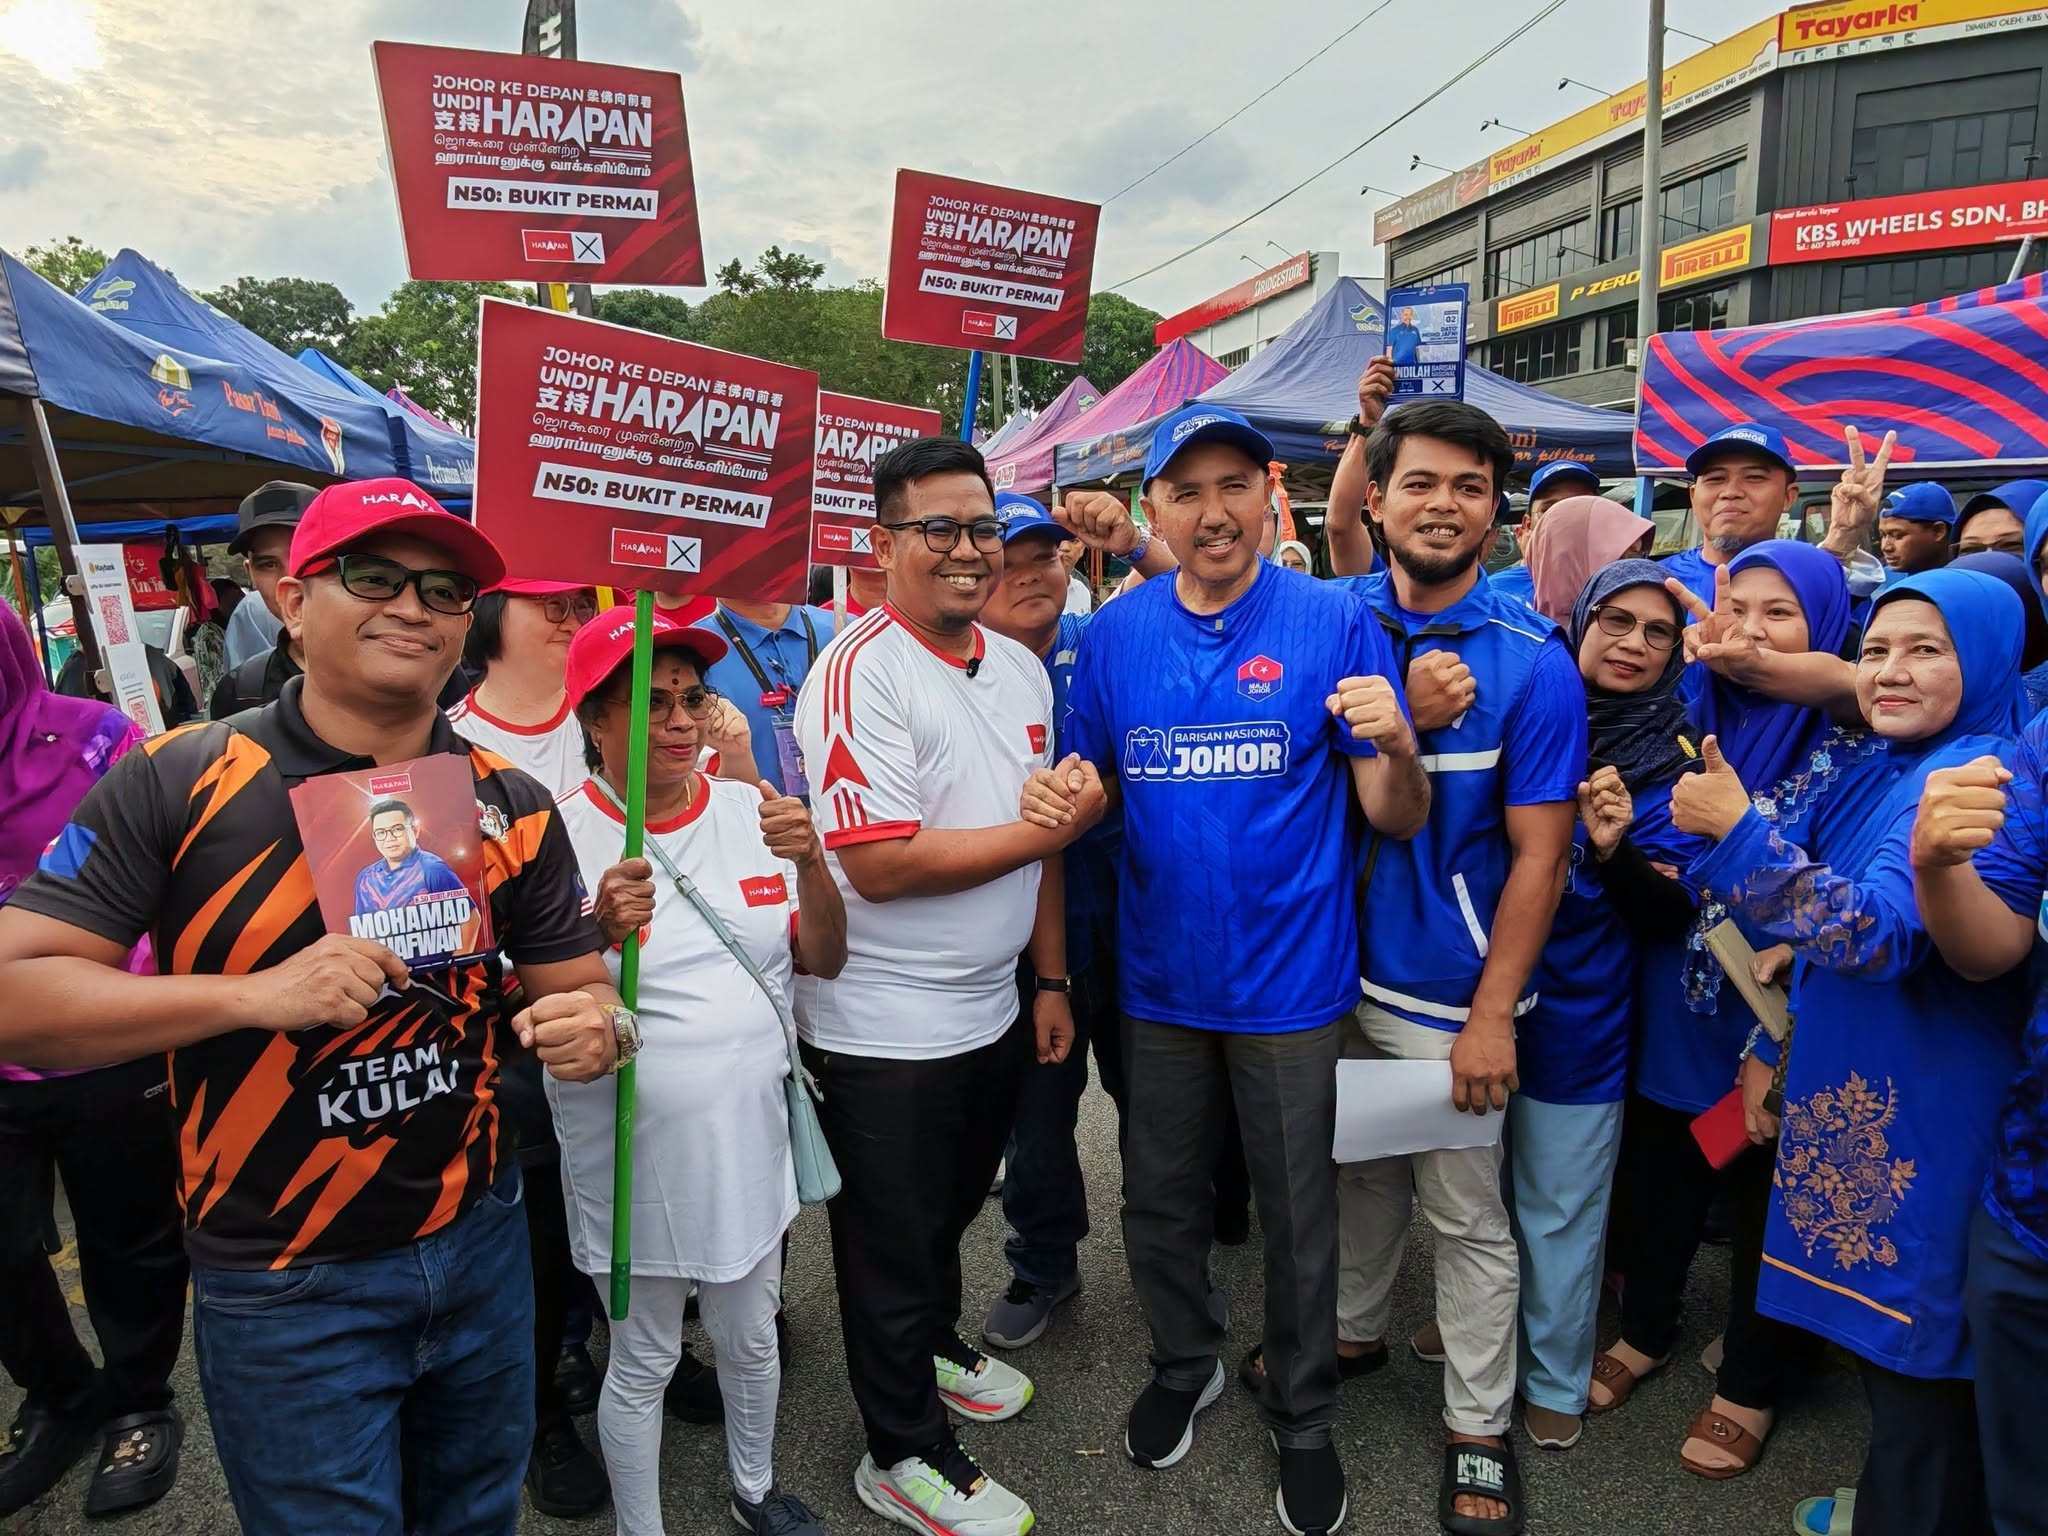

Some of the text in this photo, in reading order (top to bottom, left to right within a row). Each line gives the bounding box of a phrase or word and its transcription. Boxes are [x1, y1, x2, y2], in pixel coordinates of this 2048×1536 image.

[432, 75, 584, 102] JOHOR KE DEPAN
[432, 93, 652, 151] UNDI HARAPAN
[434, 111, 480, 133] 支持
[454, 185, 652, 212] N50: BUKIT PERMAI
[929, 196, 1030, 222] JOHOR KE DEPAN
[923, 221, 955, 239] 支持
[926, 208, 1073, 258] UNDI HARAPAN
[1796, 223, 1837, 243] KBS
[1846, 211, 1942, 238] WHEELS
[1951, 204, 2012, 227] SDN.
[1664, 233, 1747, 280] PIRELLI
[924, 275, 1058, 306] N50: BUKIT PERMAI
[1254, 261, 1305, 298] BRIDGESTONE
[1570, 270, 1641, 301] P ZERO
[1501, 290, 1555, 326] PIRELLI
[543, 346, 711, 393] JOHOR KE DEPAN
[535, 387, 589, 415] 支持
[539, 366, 781, 450] UNDI HARAPAN
[835, 417, 874, 433] DEPAN
[543, 471, 764, 520] N50: BUKIT PERMAI
[814, 494, 856, 510] BUKIT
[620, 542, 662, 555] HARAPAN
[1174, 728, 1283, 743] BARISAN NASIONAL
[1172, 743, 1282, 775] JOHOR
[349, 898, 471, 938] MOHAMAD
[339, 1042, 441, 1086] TEAM
